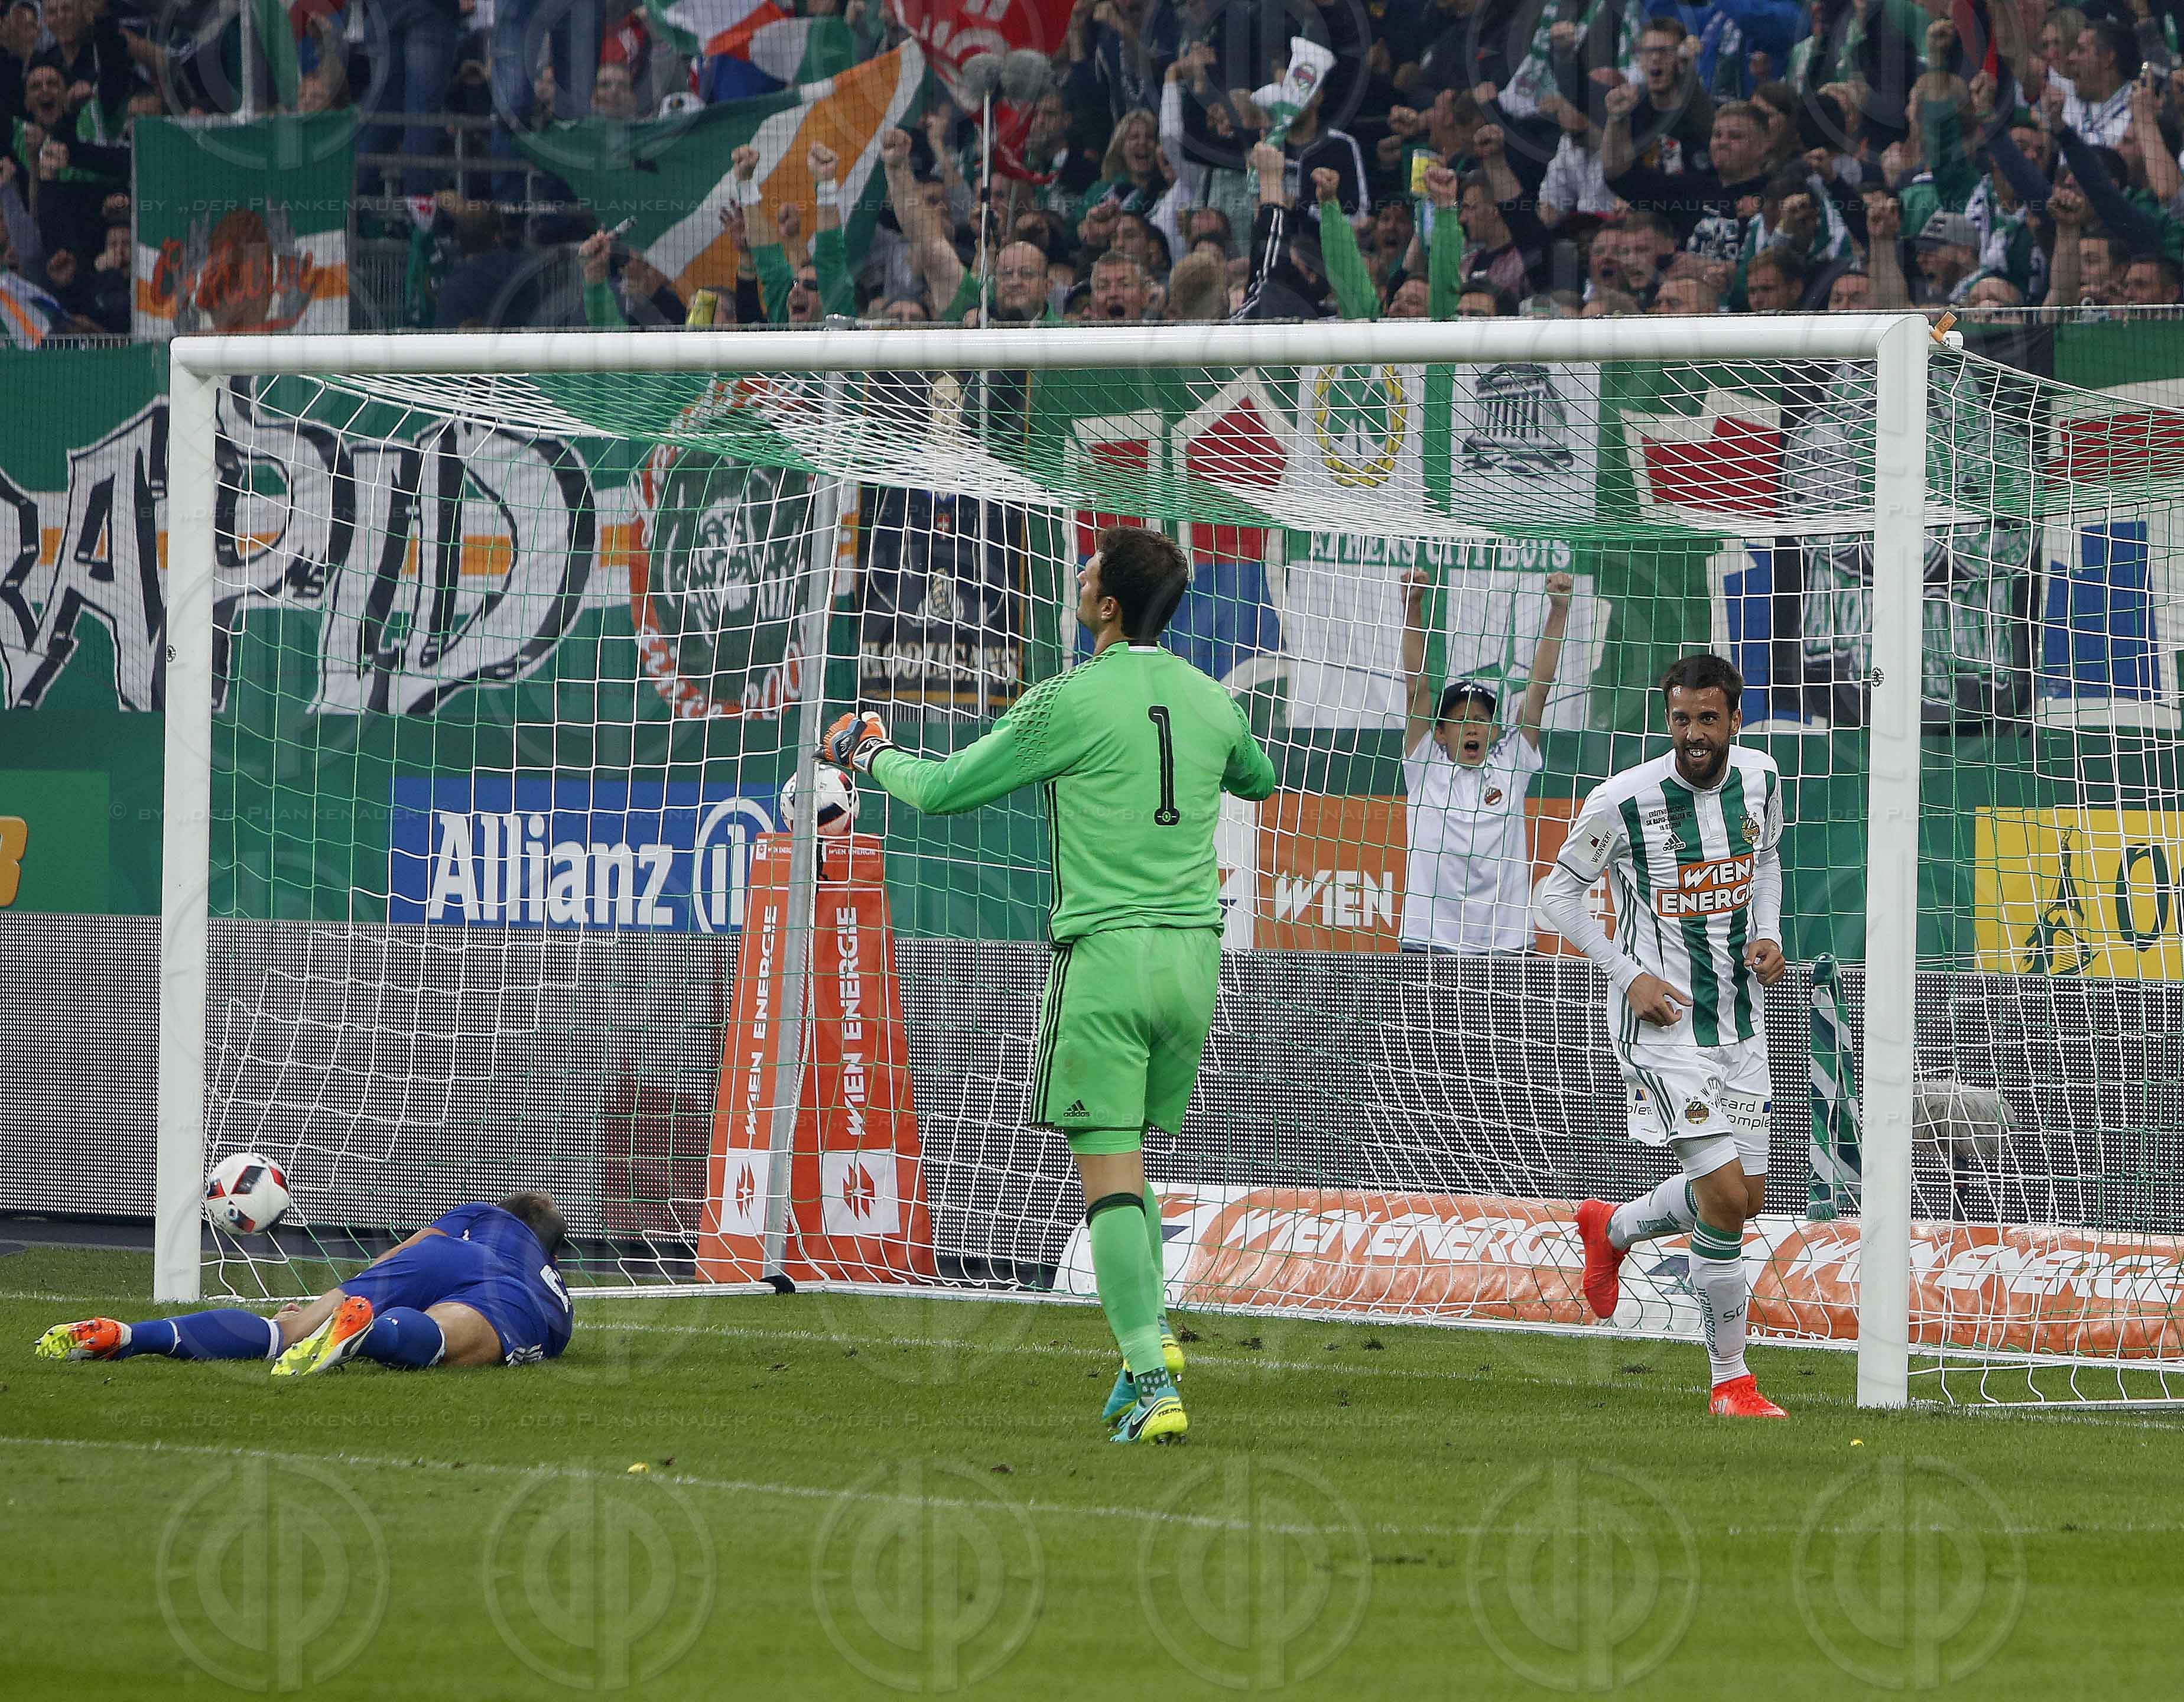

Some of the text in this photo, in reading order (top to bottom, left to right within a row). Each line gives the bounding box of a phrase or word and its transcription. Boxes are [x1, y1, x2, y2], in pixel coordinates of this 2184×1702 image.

[1148, 705, 1180, 827] 1
[428, 811, 674, 925] Allianz
[1590, 830, 1612, 863] WIENWERT
[1684, 858, 1751, 889] WIEN
[1275, 869, 1394, 928] WIEN
[745, 905, 778, 1136] WIEN ENERGIE
[836, 907, 867, 1136] WIEN ENERGIE
[1720, 1097, 1756, 1112] card
[1221, 1208, 1381, 1255] WIEN
